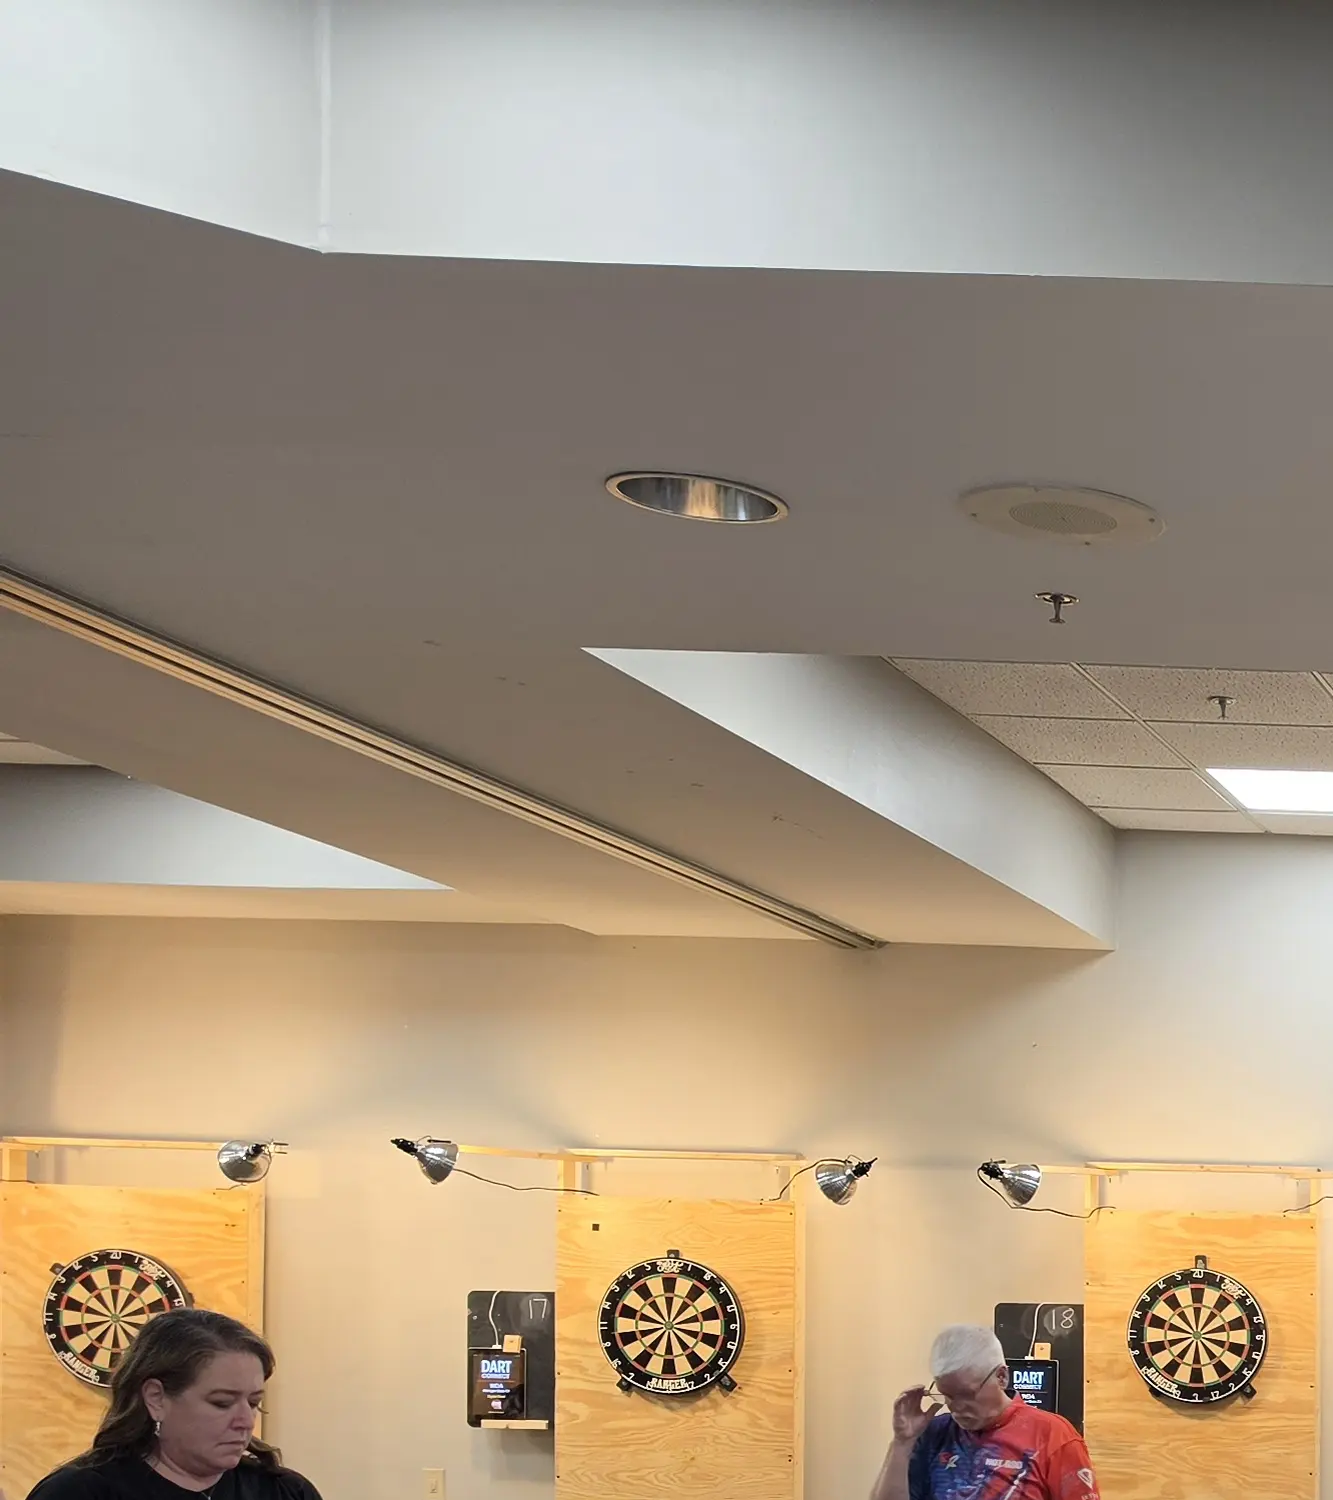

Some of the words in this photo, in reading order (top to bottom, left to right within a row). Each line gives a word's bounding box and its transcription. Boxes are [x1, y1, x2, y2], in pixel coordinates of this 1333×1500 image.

[529, 1298, 548, 1319] 17
[1052, 1308, 1075, 1330] 18
[481, 1360, 512, 1374] DART
[1013, 1371, 1044, 1384] DART
